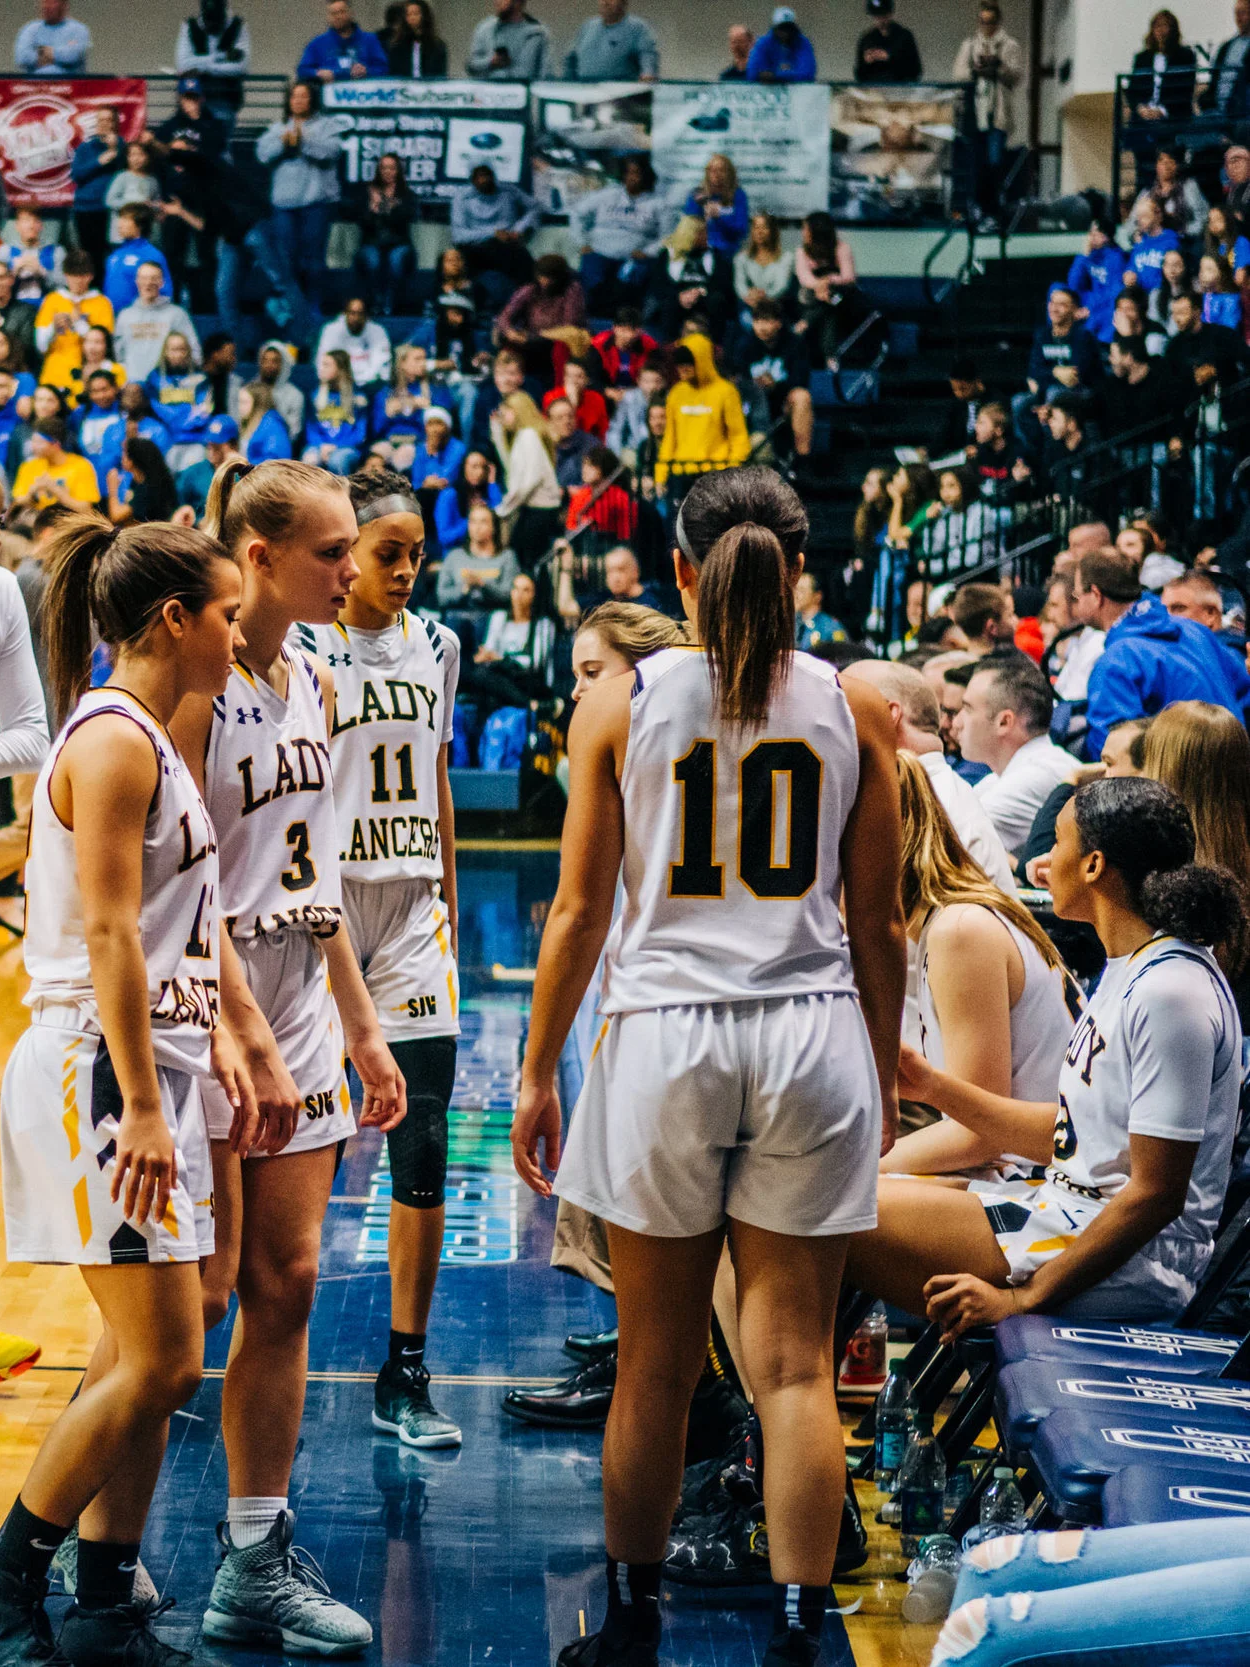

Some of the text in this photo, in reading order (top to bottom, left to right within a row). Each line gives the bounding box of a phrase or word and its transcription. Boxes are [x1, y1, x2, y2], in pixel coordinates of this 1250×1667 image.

[331, 680, 438, 739] LADY
[370, 743, 418, 803] 11
[667, 737, 825, 900] 10
[280, 819, 319, 893] 3
